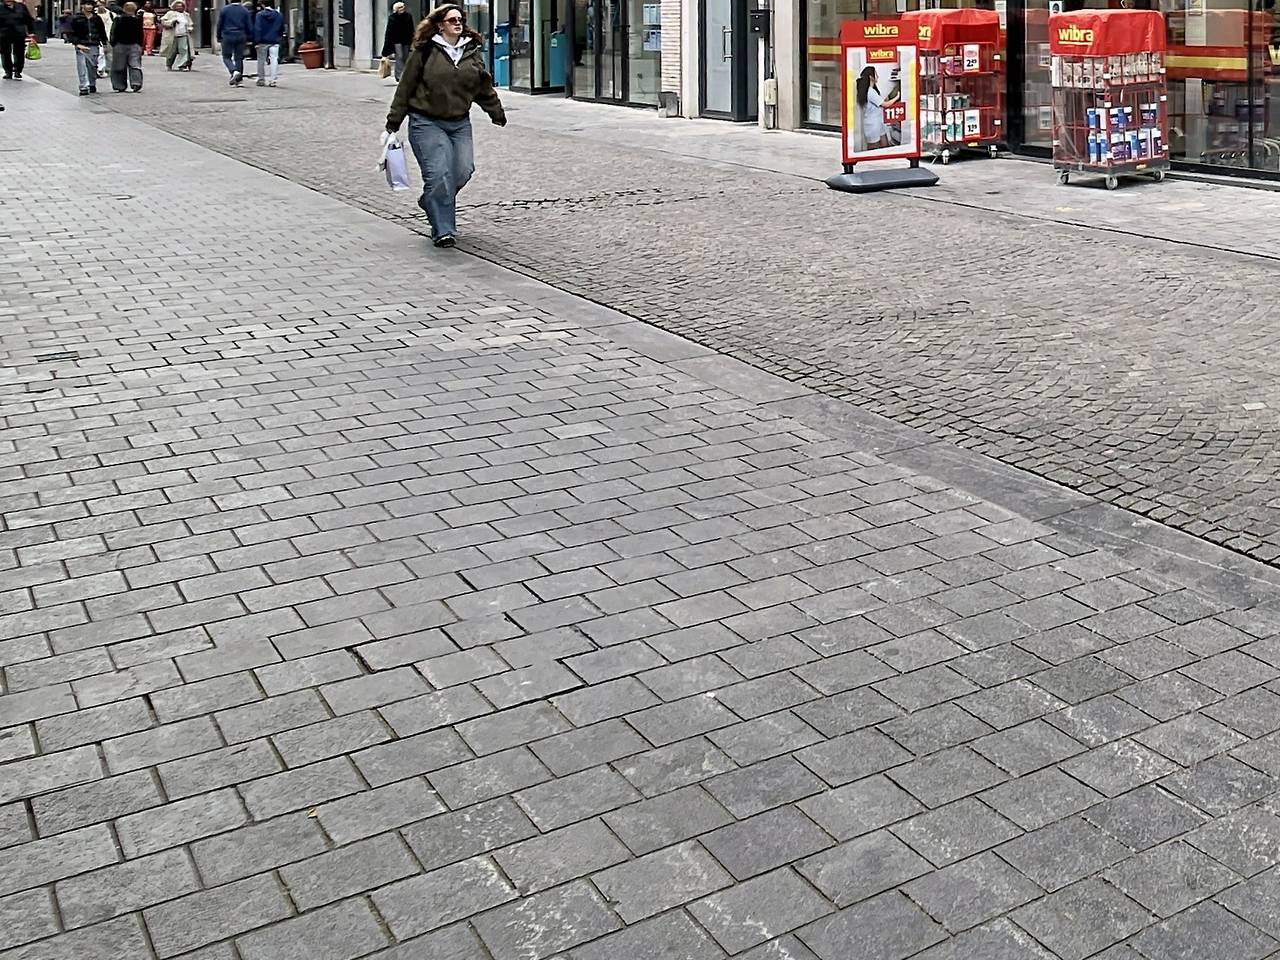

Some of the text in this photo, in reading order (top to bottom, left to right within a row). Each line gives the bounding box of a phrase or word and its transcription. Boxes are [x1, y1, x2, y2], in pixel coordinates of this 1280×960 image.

[864, 23, 899, 35] wibra
[1058, 25, 1094, 41] wibra
[870, 48, 894, 58] wibra
